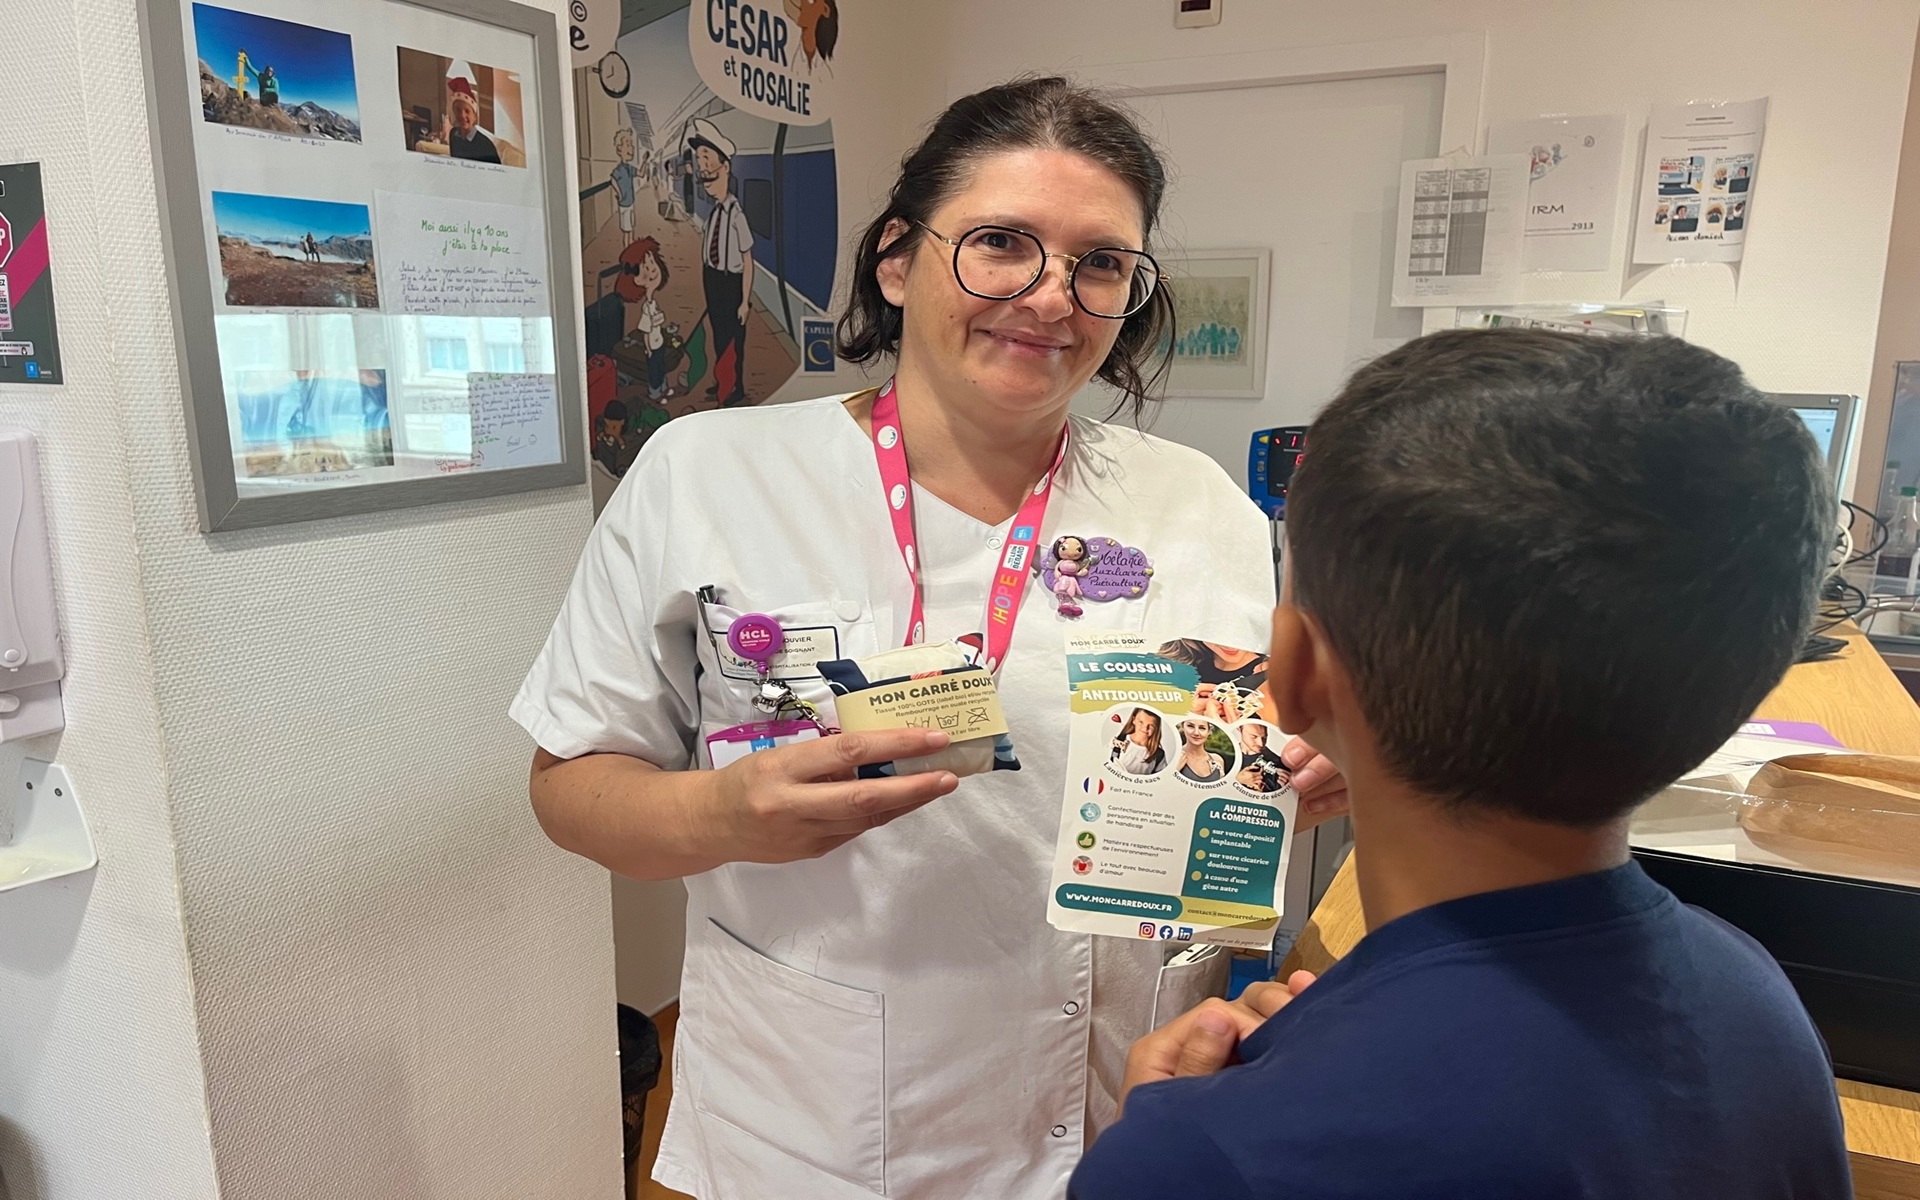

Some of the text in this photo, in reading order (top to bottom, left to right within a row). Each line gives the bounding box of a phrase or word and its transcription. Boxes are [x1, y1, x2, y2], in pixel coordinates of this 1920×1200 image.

[724, 55, 737, 77] et
[1532, 204, 1564, 214] IRM
[421, 219, 434, 232] Moi
[438, 222, 458, 233] aussi
[484, 224, 494, 236] 10
[1571, 222, 1594, 231] 2013
[807, 339, 832, 365] C
[1092, 550, 1143, 568] Mélanie
[1091, 567, 1137, 577] Auxiliaire
[740, 629, 770, 639] HCL
[1092, 638, 1119, 646] CARRÉ
[1078, 661, 1173, 674] LE COUSSIN
[869, 676, 993, 707] MON CARRÉ DOUX
[1082, 688, 1184, 703] ANTIDOULEUR
[875, 706, 896, 715] Tissus
[897, 702, 916, 711] 100%
[936, 695, 955, 704] (label
[955, 693, 967, 702] bio)
[895, 705, 940, 718] Rembourrage
[1103, 761, 1133, 783] Lanières
[1145, 776, 1161, 784] sacs
[1172, 771, 1227, 790] Sous vêtements
[1132, 789, 1153, 797] France
[1232, 781, 1261, 800] Ceinture
[1271, 784, 1291, 798] sécurit
[1223, 804, 1268, 818] AU REVOIR
[1107, 813, 1139, 822] personnes
[1149, 818, 1175, 827] situation
[1115, 820, 1143, 830] handicap
[1209, 810, 1280, 829] LA COMPRESSION
[1210, 837, 1252, 849] implantable
[1225, 830, 1243, 838] votre
[1244, 832, 1276, 843] dispositif
[1110, 846, 1159, 858] l'environnement
[1130, 842, 1174, 853] respectueuses
[1222, 853, 1240, 862] votre
[1240, 856, 1270, 866] cicatrice
[1099, 868, 1124, 877] d'amour
[1138, 866, 1167, 876] beaucoup
[1207, 860, 1250, 873] douloureuse
[1210, 875, 1229, 883] cause
[1230, 876, 1249, 885] d'une
[1065, 892, 1172, 912] WWW.MONCARREDOUX.FR
